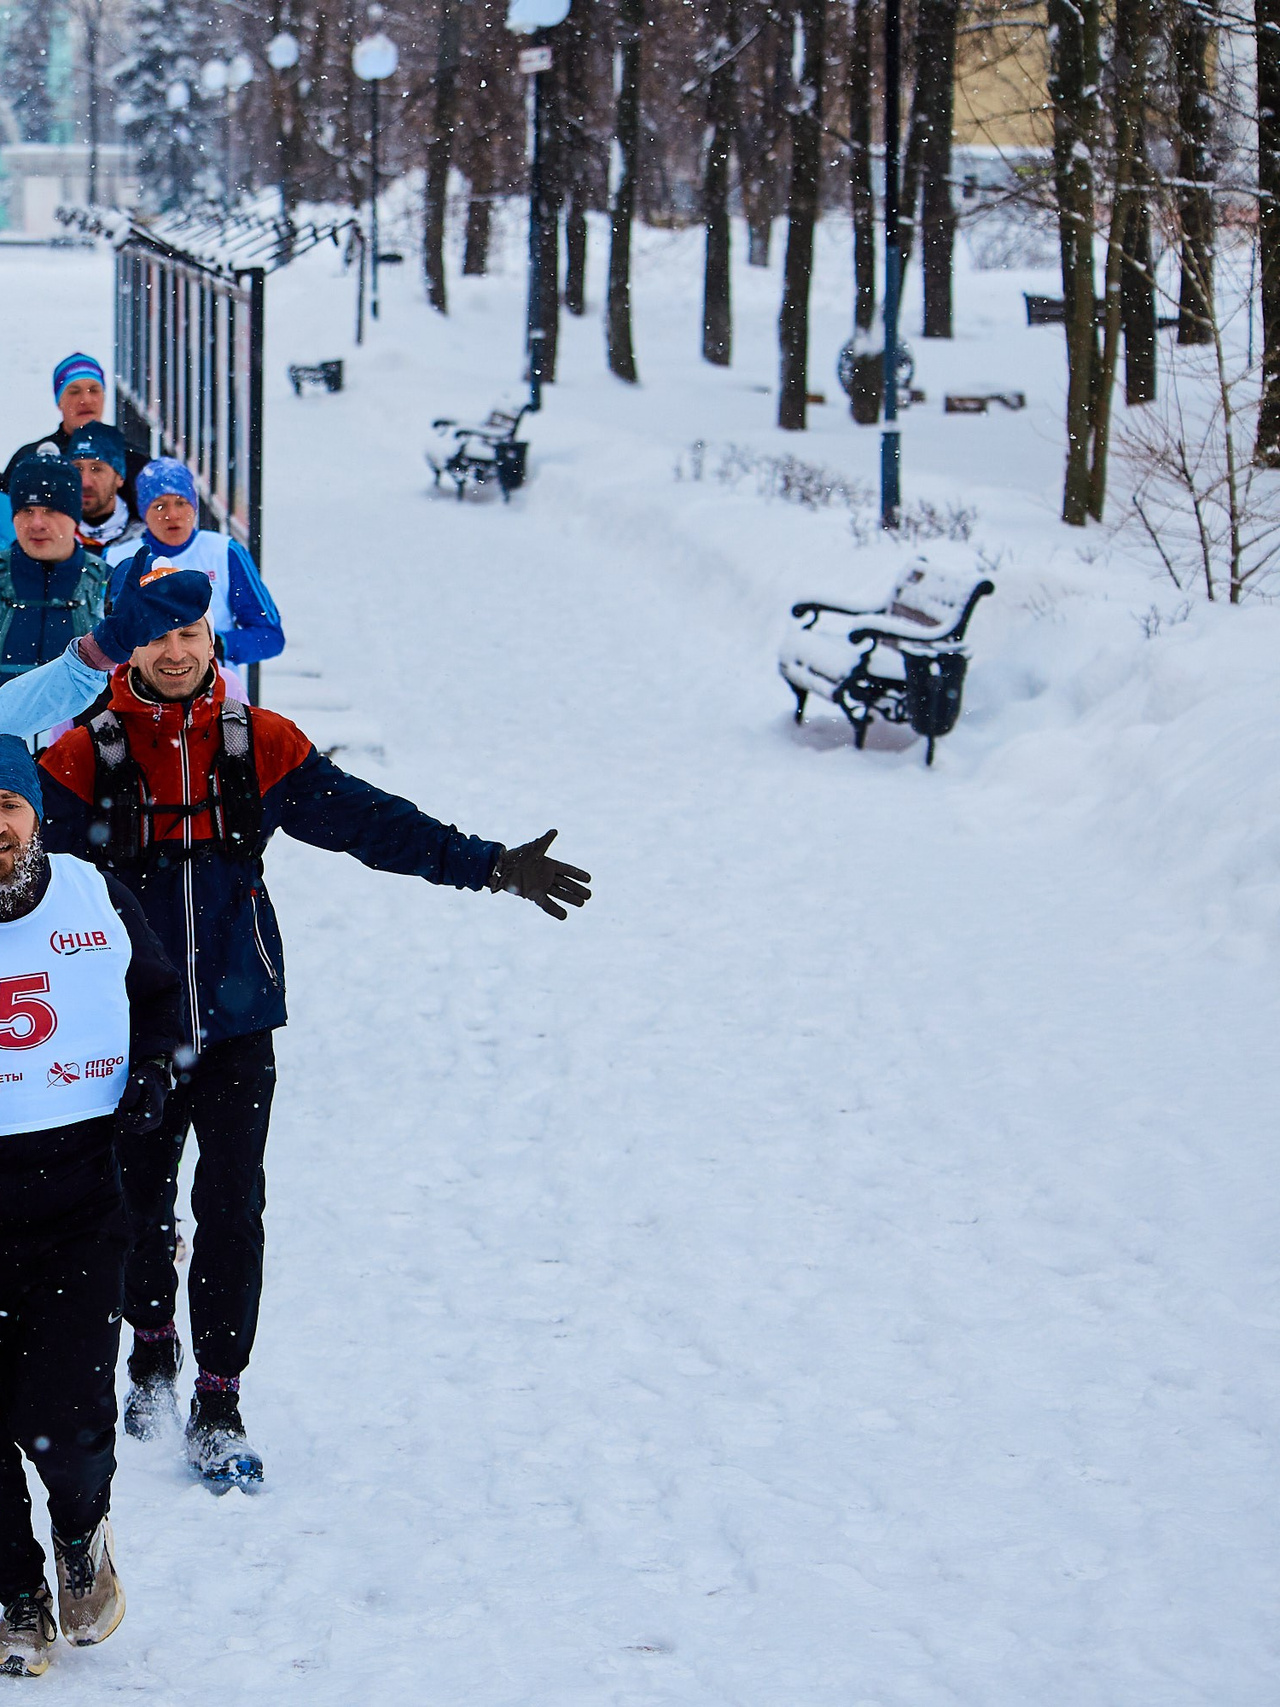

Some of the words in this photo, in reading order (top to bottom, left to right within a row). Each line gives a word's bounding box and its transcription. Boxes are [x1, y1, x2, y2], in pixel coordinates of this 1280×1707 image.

[58, 931, 107, 950] НЦВ
[85, 1056, 124, 1069] ППОО
[85, 1066, 114, 1078] НЦВ
